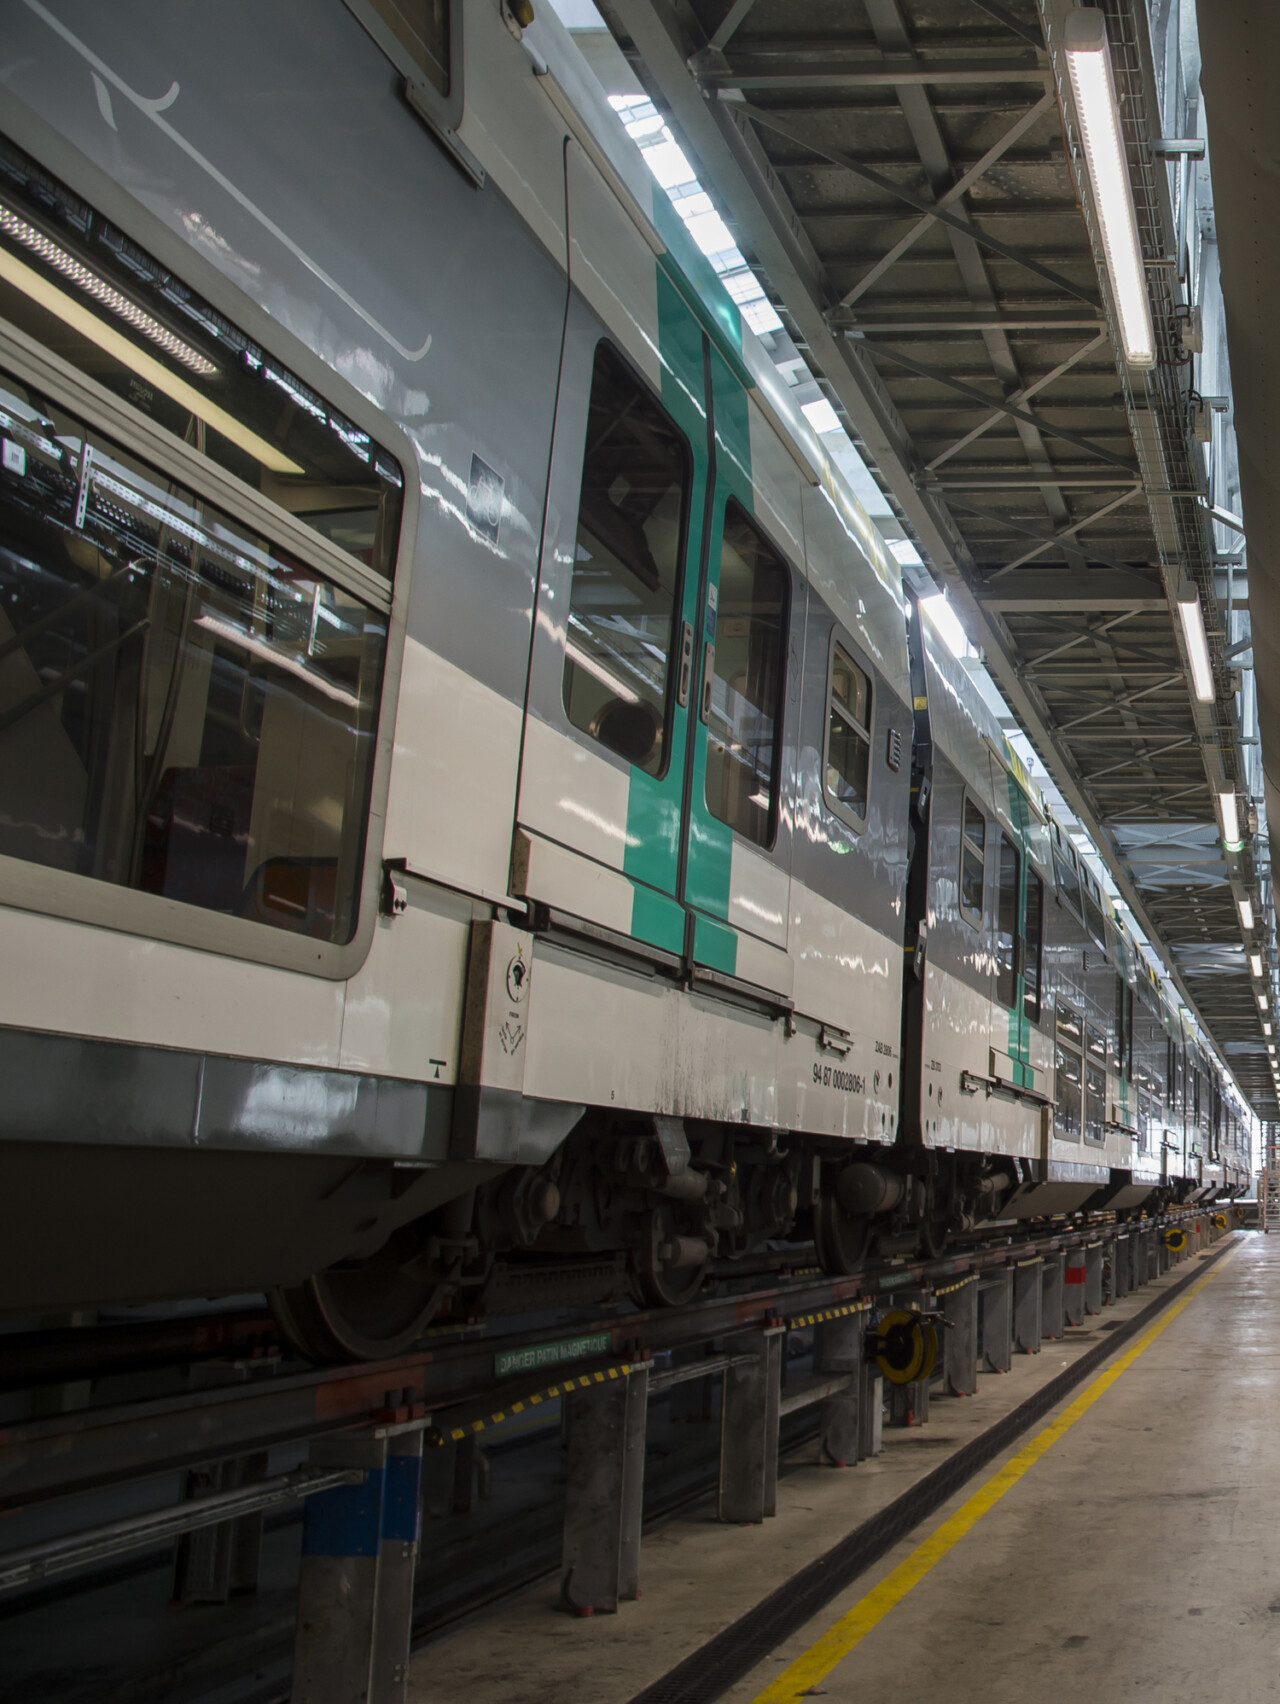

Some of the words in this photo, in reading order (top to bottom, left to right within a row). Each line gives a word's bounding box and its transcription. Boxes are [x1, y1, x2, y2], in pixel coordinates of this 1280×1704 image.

[812, 1062, 822, 1085] 94
[823, 1065, 832, 1087] 87
[832, 1068, 866, 1095] 0002806-1
[500, 1352, 536, 1373] DANGER
[536, 1346, 559, 1364] PATIN
[559, 1336, 608, 1359] MAGNETIQUE
